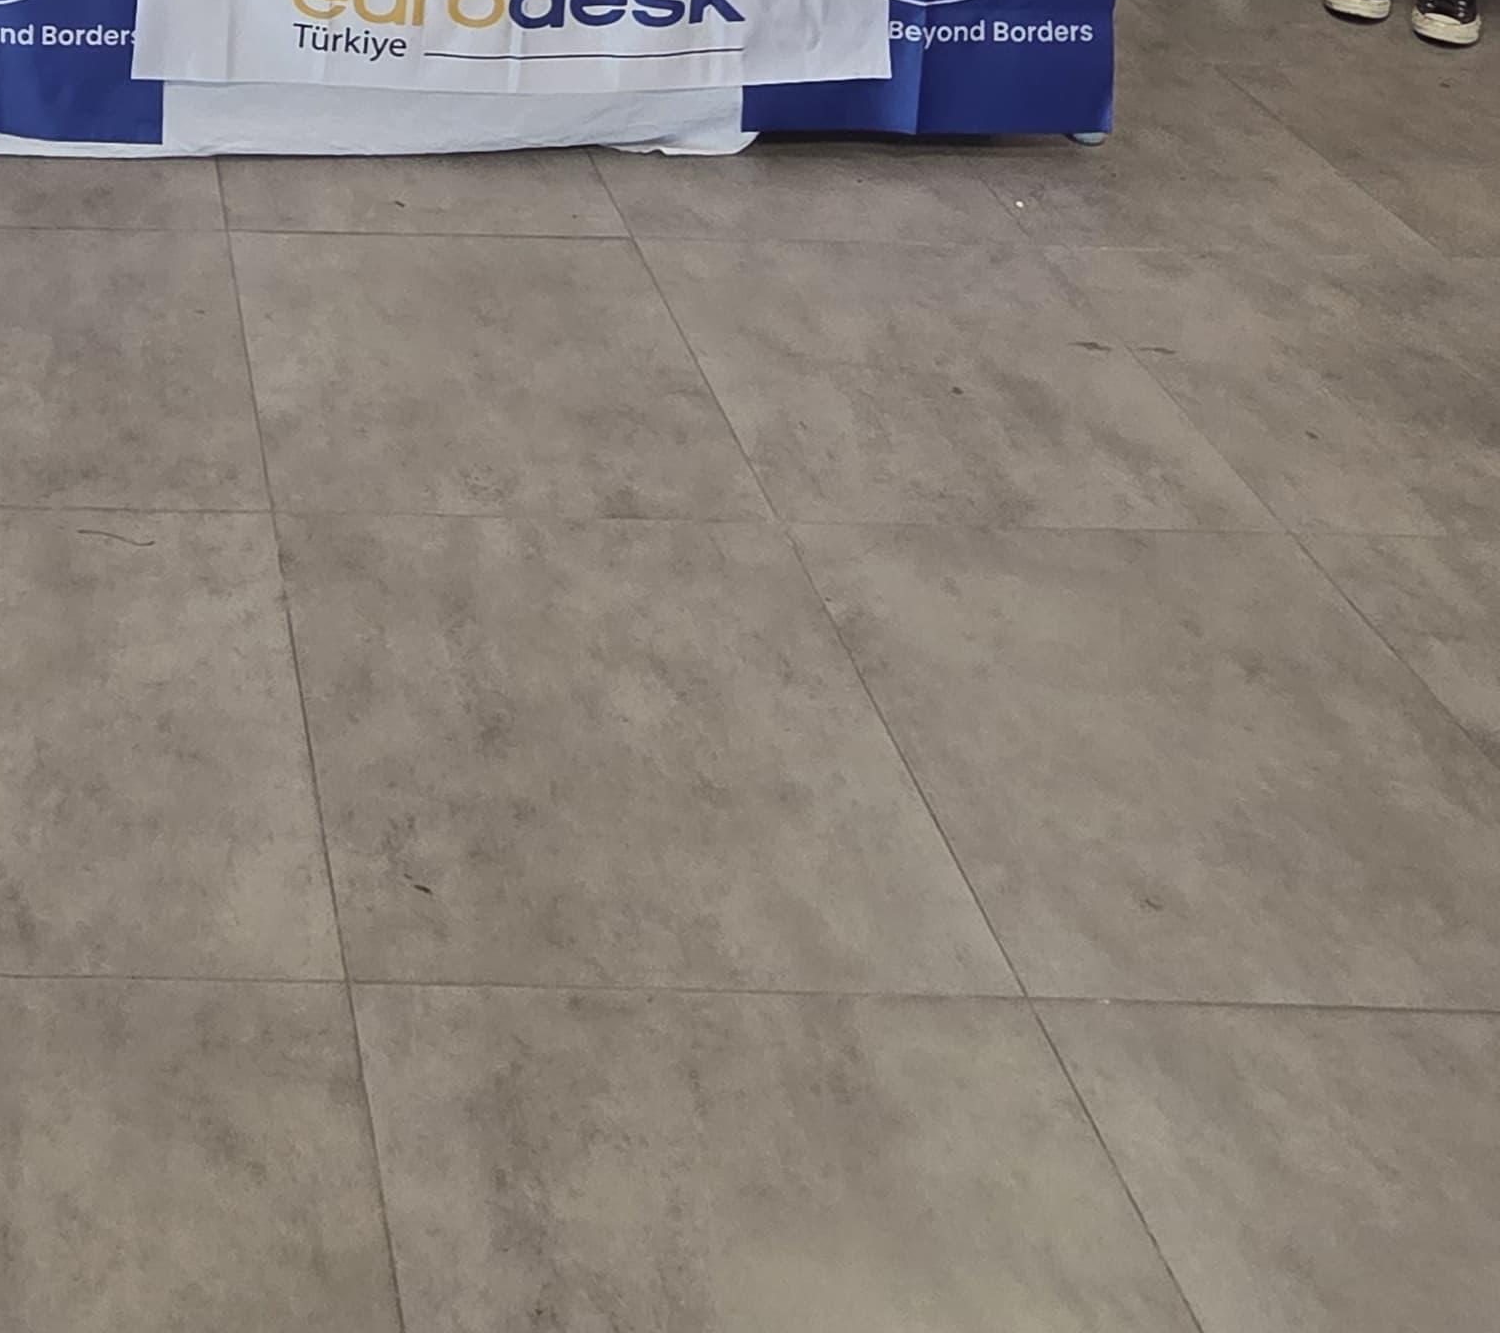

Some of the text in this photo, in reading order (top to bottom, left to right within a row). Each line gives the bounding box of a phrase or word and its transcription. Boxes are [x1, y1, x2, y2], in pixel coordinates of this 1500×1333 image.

[293, 23, 407, 61] Türkiye
[889, 20, 1093, 49] Beyond Borders
